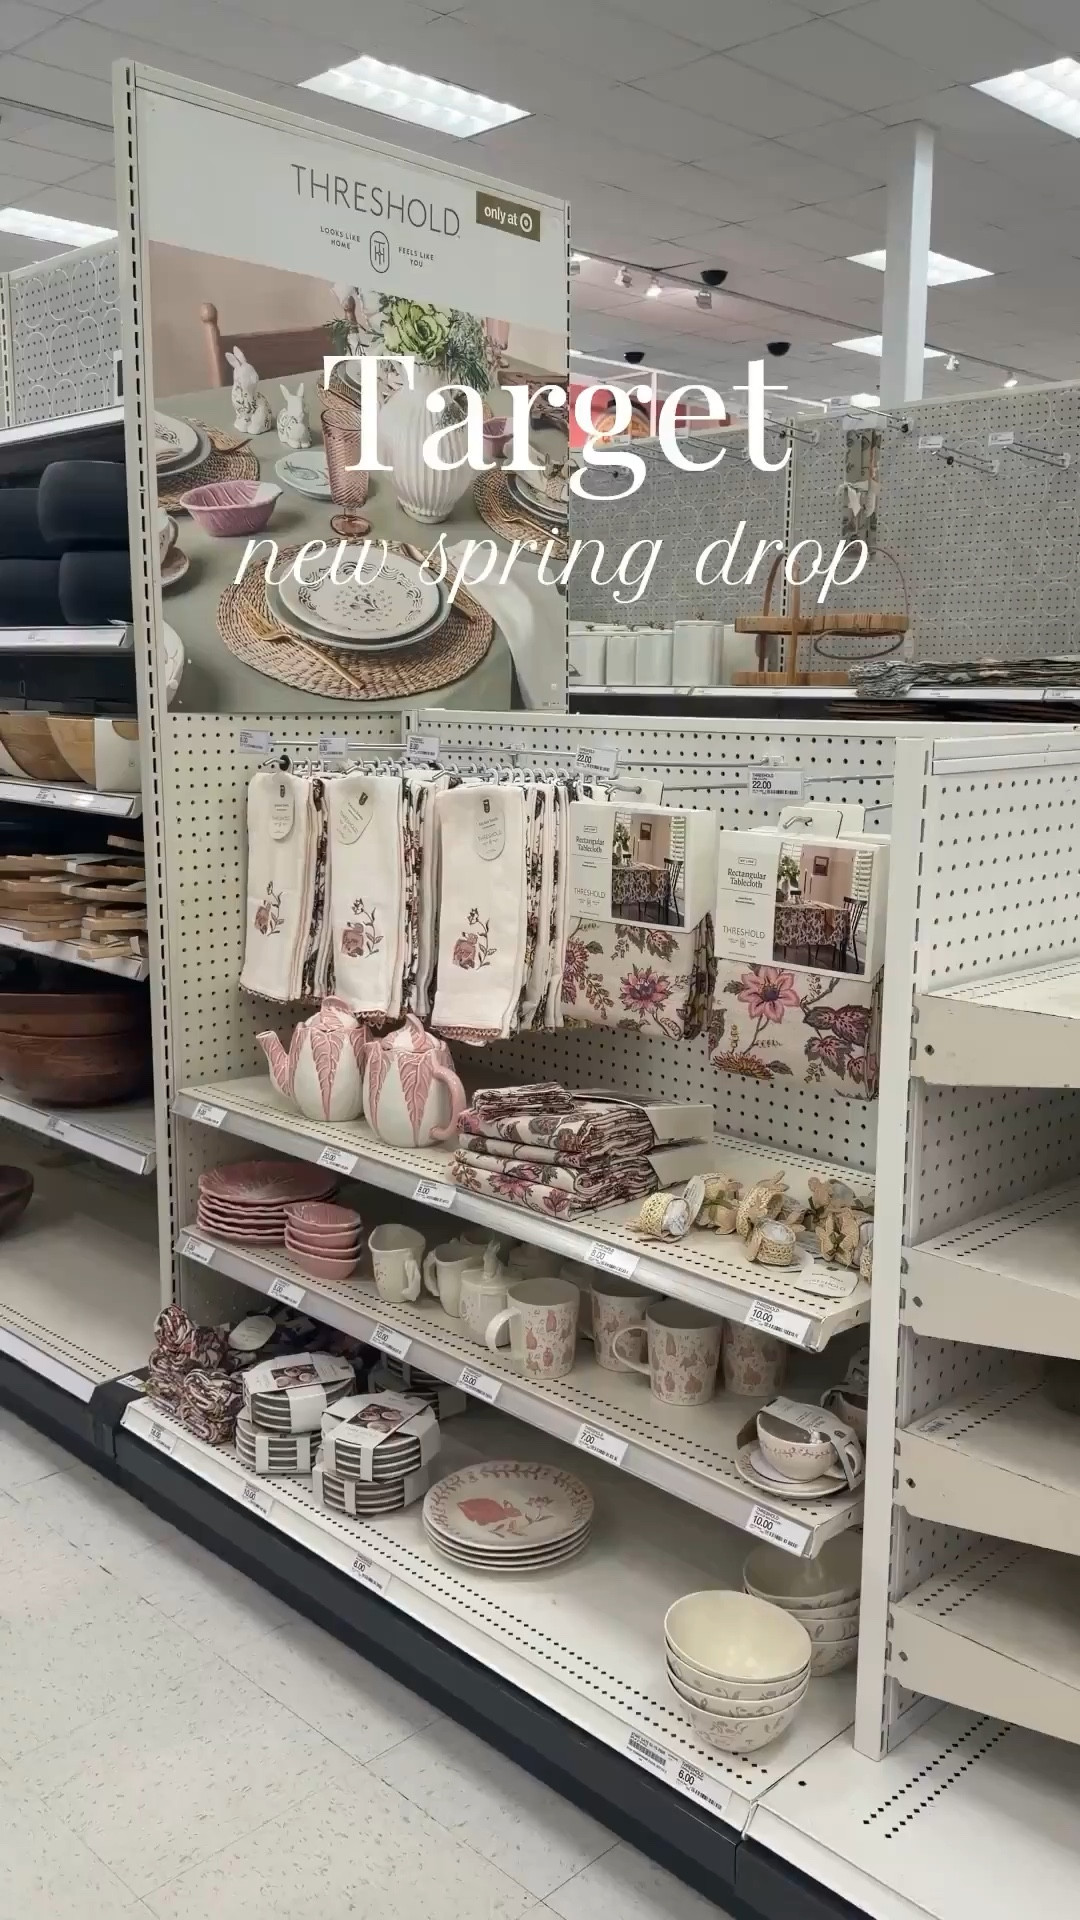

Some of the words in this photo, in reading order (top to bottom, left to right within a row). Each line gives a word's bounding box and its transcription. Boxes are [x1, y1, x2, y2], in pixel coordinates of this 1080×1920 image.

[290, 163, 460, 236] THRESHOLD
[484, 206, 506, 225] only
[507, 212, 518, 226] at
[320, 225, 344, 238] LOOKS
[343, 230, 361, 242] LIKE
[330, 239, 351, 250] HOME
[398, 246, 418, 257] FEELS
[419, 250, 434, 261] LIKE
[410, 258, 423, 268] YOU
[577, 754, 592, 764] 22.00
[752, 780, 772, 789] 22.00
[576, 835, 605, 846] Rectangular
[578, 844, 602, 853] Tablecloth
[727, 868, 767, 880] Rectangular
[730, 877, 763, 888] Tablecloth
[574, 888, 606, 899] THRESHOLD
[722, 925, 766, 939] THRESHOLD
[591, 1249, 606, 1260] 8.00
[752, 1309, 773, 1323] 10.00
[462, 1374, 477, 1386] 15.00
[580, 1431, 595, 1445] 7.00
[752, 1515, 774, 1530] 10.00
[678, 1769, 695, 1786] 6.00
